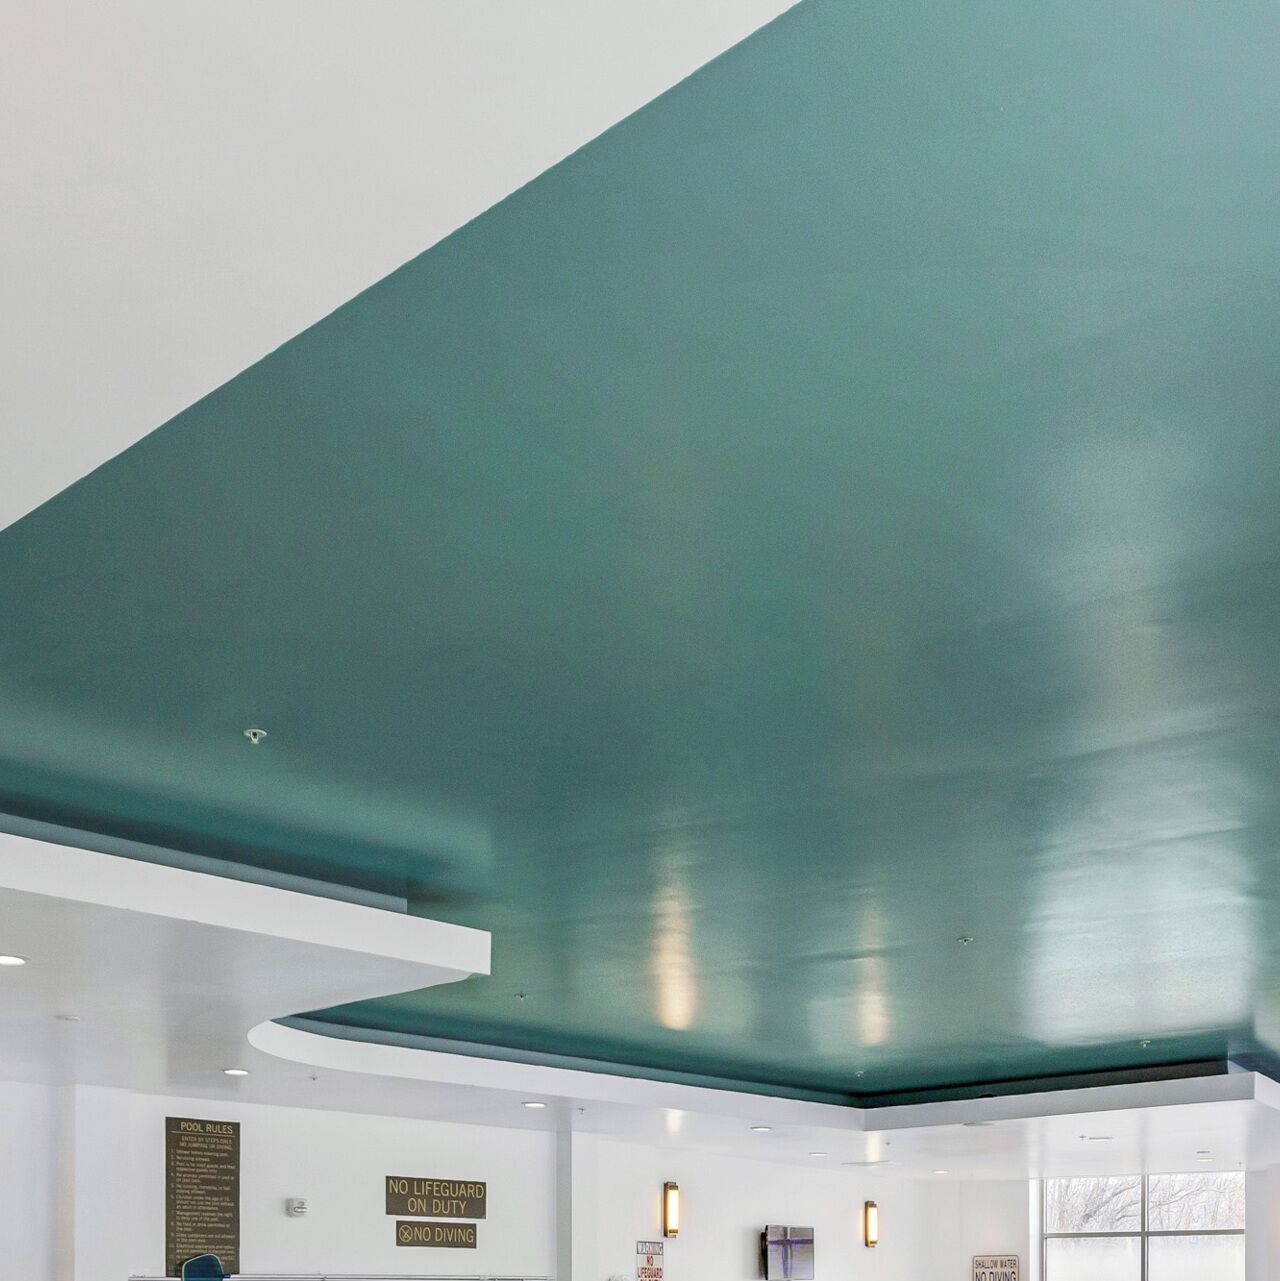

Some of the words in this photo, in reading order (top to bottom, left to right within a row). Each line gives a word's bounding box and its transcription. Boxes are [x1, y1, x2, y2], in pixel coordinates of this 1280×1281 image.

[180, 1122, 203, 1132] POOL
[206, 1124, 233, 1134] RULES
[389, 1180, 408, 1194] NO
[414, 1180, 484, 1198] LIFEGUARD
[408, 1198, 426, 1212] ON
[432, 1200, 466, 1214] DUTY
[414, 1227, 431, 1241] NO
[435, 1228, 474, 1243] DIVING
[646, 1256, 654, 1266] NO
[976, 1260, 998, 1269] SHALLOW
[1000, 1259, 1016, 1268] WATER
[638, 1267, 662, 1278] LIFEGUARD
